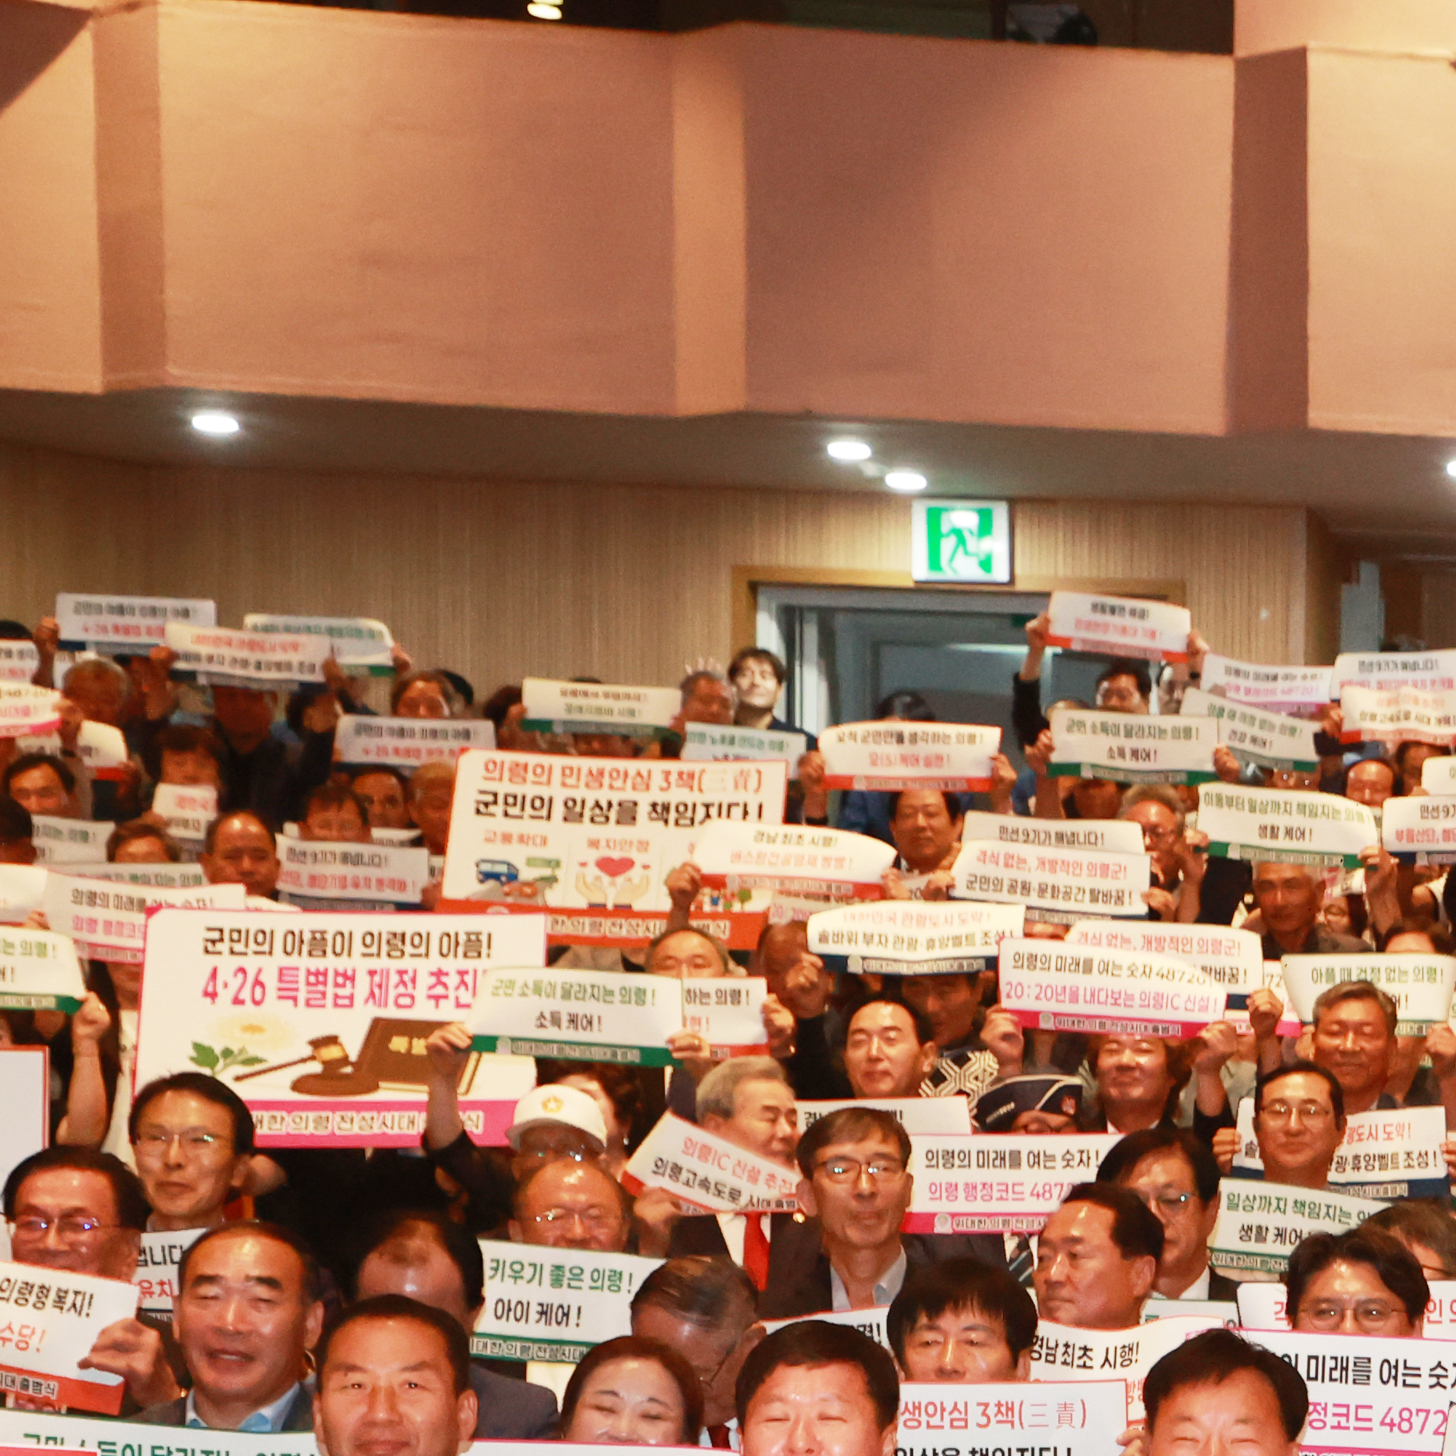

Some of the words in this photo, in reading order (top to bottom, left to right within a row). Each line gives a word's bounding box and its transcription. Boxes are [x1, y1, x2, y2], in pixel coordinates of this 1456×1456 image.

[484, 760, 552, 787] 의령의
[560, 762, 650, 790] 민생안심
[475, 791, 552, 820] 군민의
[562, 797, 638, 823] 일상을
[203, 928, 274, 957] 군민의
[282, 929, 353, 957] 아픔이
[361, 931, 429, 958] 의령의
[1012, 952, 1052, 969] 의령의
[1055, 955, 1093, 975] 미래를
[277, 968, 356, 1009] 특별법
[365, 970, 418, 1009] 제정
[561, 980, 616, 1003] 달라지는
[534, 1012, 562, 1030] 소득
[925, 1148, 971, 1170] 의령의
[976, 1148, 1022, 1171] 미래를
[1306, 1358, 1373, 1385] 미래를
[1379, 1360, 1422, 1388] 여는
